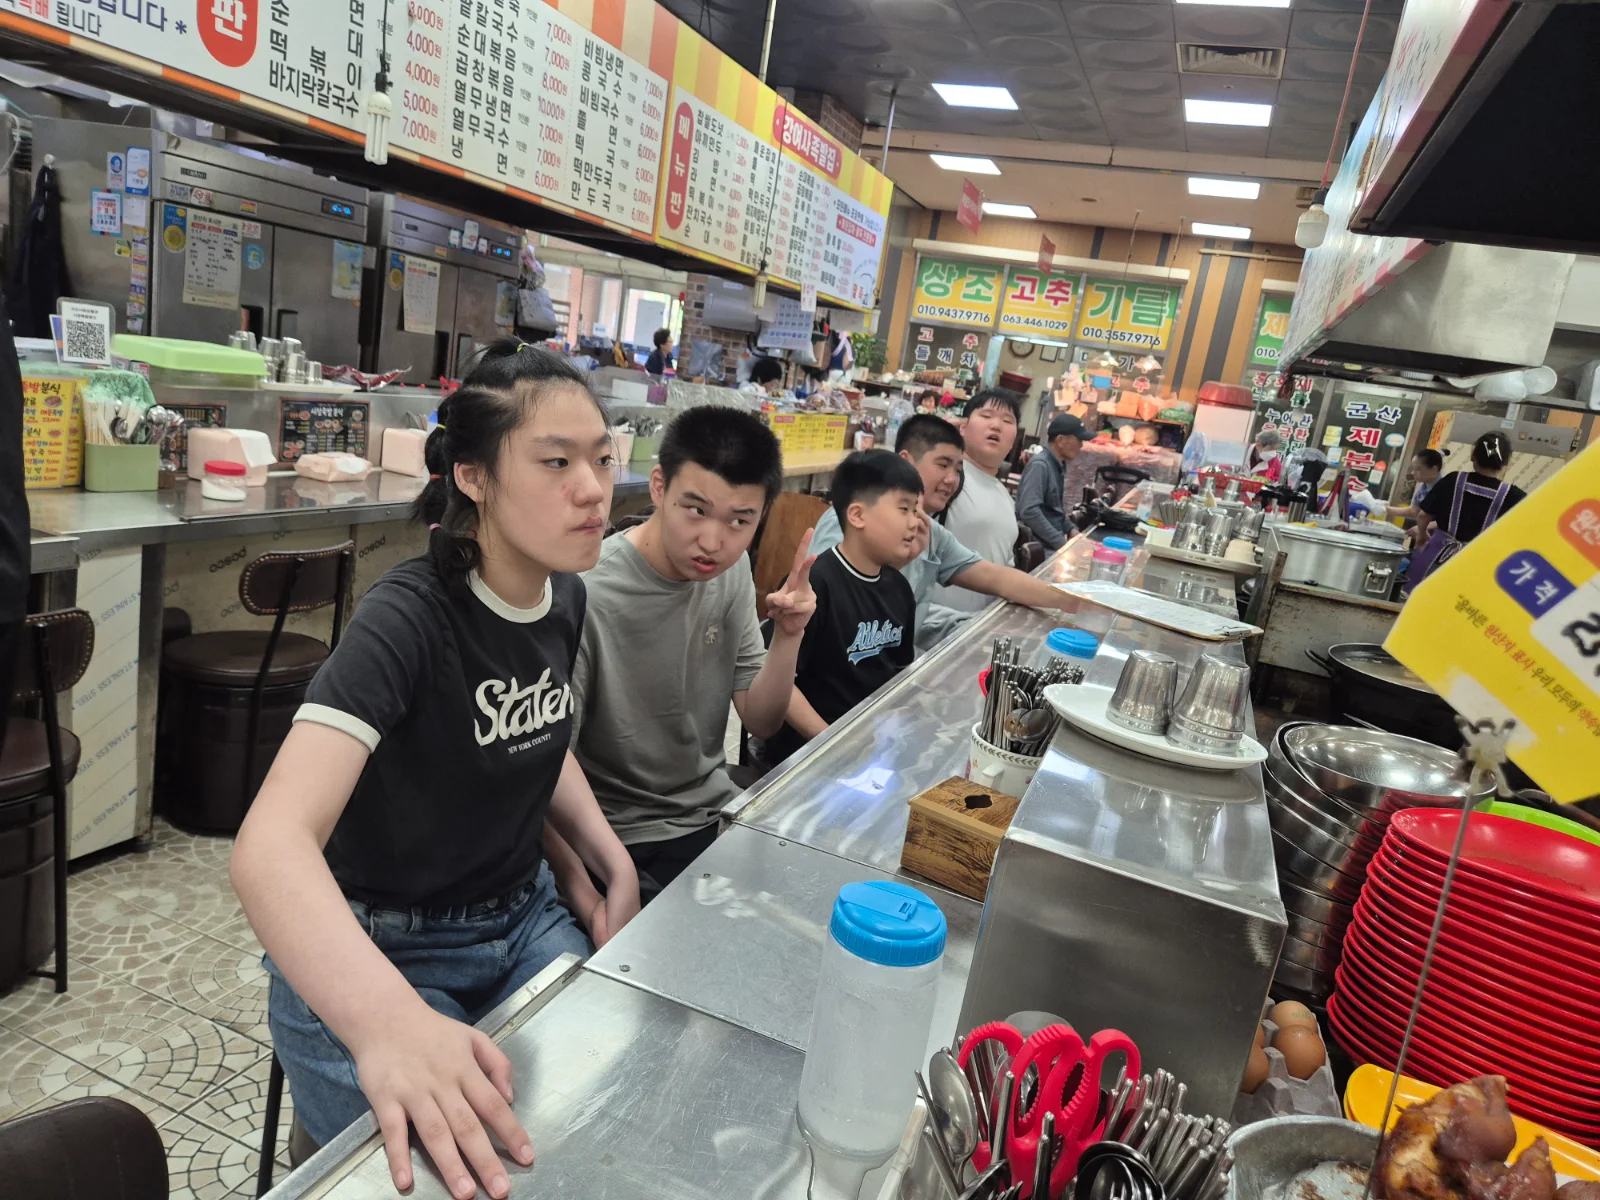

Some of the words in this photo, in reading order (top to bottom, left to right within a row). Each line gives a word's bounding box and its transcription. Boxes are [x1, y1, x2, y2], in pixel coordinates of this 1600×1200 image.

[56, 2, 102, 36] 됩니다
[211, 0, 248, 41] 판
[408, 1, 443, 31] 3,000원
[407, 30, 441, 59] 4,000원
[546, 22, 573, 46] 7,000원
[457, 23, 516, 72] 순대볶음
[541, 71, 568, 97] 8,000원
[544, 46, 570, 71] 7,000원
[584, 38, 624, 78] 비빔냉면
[405, 61, 439, 88] 4,000원
[455, 50, 515, 99] 곱창볶음
[581, 61, 622, 98] 콩국수
[269, 60, 359, 118] 바지락칼국수
[402, 116, 437, 144] 7,000원
[403, 89, 438, 118] 5,000원
[454, 79, 512, 124] 열무냉면
[539, 123, 564, 145] 7,000원
[580, 85, 619, 121] 비빔국수
[452, 107, 510, 149] 열무국수
[537, 147, 562, 169] 7,000원
[534, 170, 560, 190] 6,000원
[574, 157, 613, 190] 떡만두국
[670, 114, 690, 216] 메뉴판
[571, 181, 611, 212] 만두국
[922, 262, 999, 304] 상조
[1010, 274, 1073, 308] 고추
[1088, 284, 1170, 328] 기름
[917, 304, 990, 323] 010.9437.9716
[1003, 313, 1068, 331] 063.446.1029
[918, 327, 979, 350] 고추
[1082, 326, 1161, 346] 010.3557.9716
[915, 344, 976, 369] 들깨차
[41, 382, 61, 395] 분식
[1345, 401, 1402, 425] 군산
[1508, 560, 1559, 606] 가격
[101, 593, 137, 622] STAINLESS
[847, 619, 904, 654] Athletics
[98, 661, 134, 691] STAINLESS
[1483, 624, 1517, 654] 원산지
[1509, 649, 1537, 671] 표시
[1530, 667, 1555, 689] 우리
[1547, 684, 1584, 713] 모두의
[75, 690, 97, 707] STEEL
[474, 667, 575, 747] Staten
[95, 728, 130, 761] STAINLESS
[508, 745, 518, 754] NEW
[518, 741, 532, 751] YORK
[531, 732, 552, 746] COUNTY
[93, 795, 128, 828] STAINLESS
